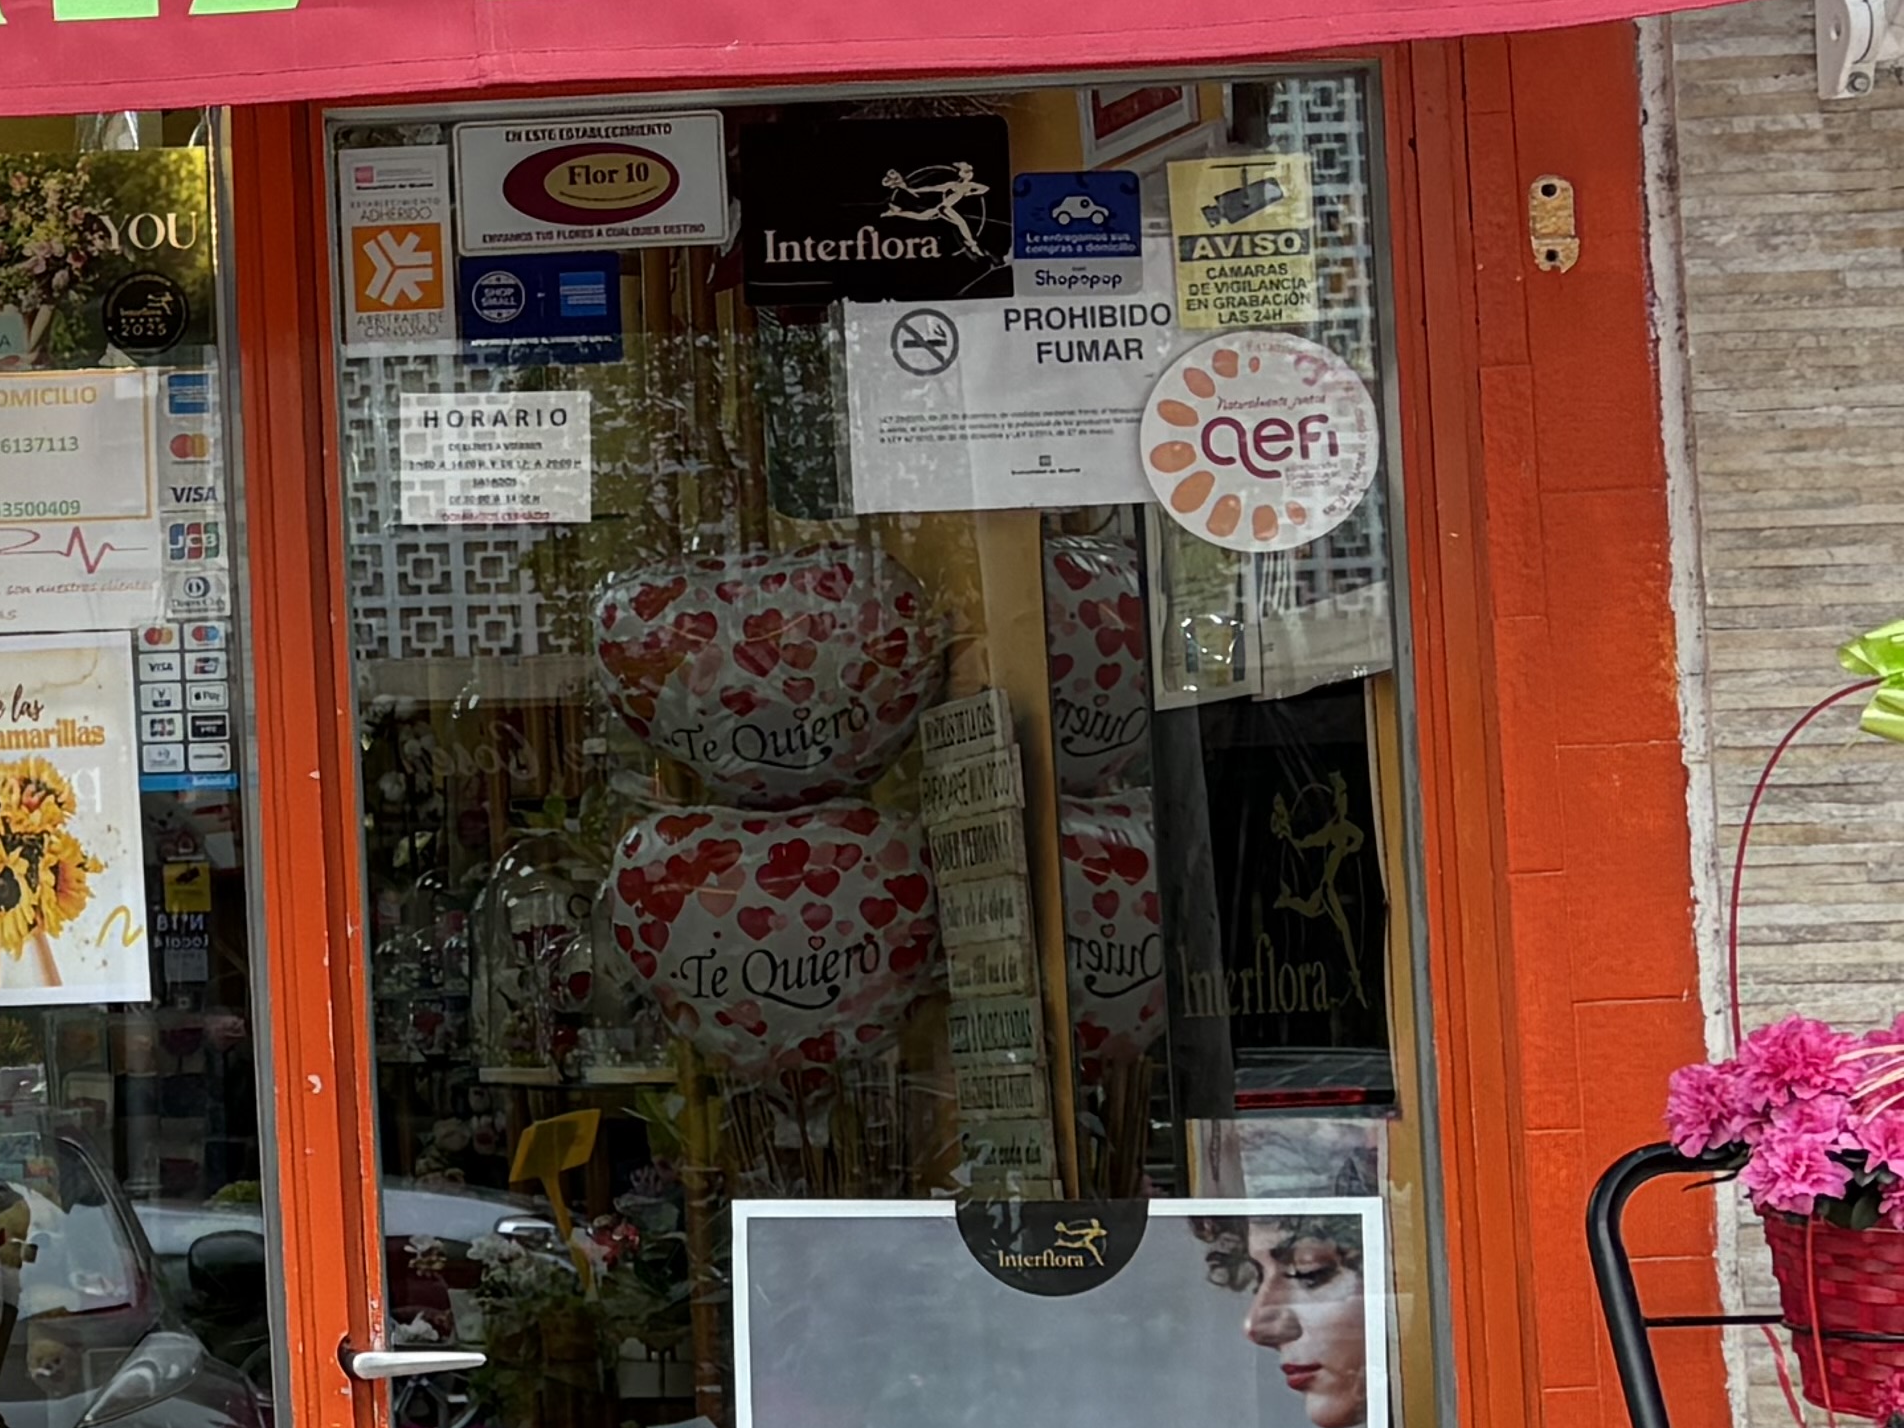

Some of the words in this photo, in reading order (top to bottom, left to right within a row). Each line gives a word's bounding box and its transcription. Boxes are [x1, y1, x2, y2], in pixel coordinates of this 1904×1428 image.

[568, 164, 618, 185] Flor
[625, 162, 650, 183] 10
[100, 211, 197, 251] YOU
[763, 225, 941, 262] Interflora
[1192, 232, 1302, 259] AVISO
[1034, 268, 1123, 290] Shopopop
[1188, 283, 1211, 296] DE
[1214, 277, 1307, 293] VIGILANCIA
[1003, 302, 1172, 332] PROHIBIDO
[1186, 298, 1209, 310] EN
[1218, 311, 1249, 324] LAS
[1254, 309, 1283, 322] 24H
[1035, 338, 1144, 364] FUMAR
[423, 408, 568, 429] HORARIO
[1200, 414, 1339, 479] aefi
[169, 485, 219, 503] VISA
[10, 682, 45, 724] las
[672, 725, 722, 760] Te
[730, 697, 870, 772] Quiero
[678, 949, 733, 1000] Te
[743, 936, 882, 1010] Quiero
[997, 1245, 1086, 1270] Interflora
